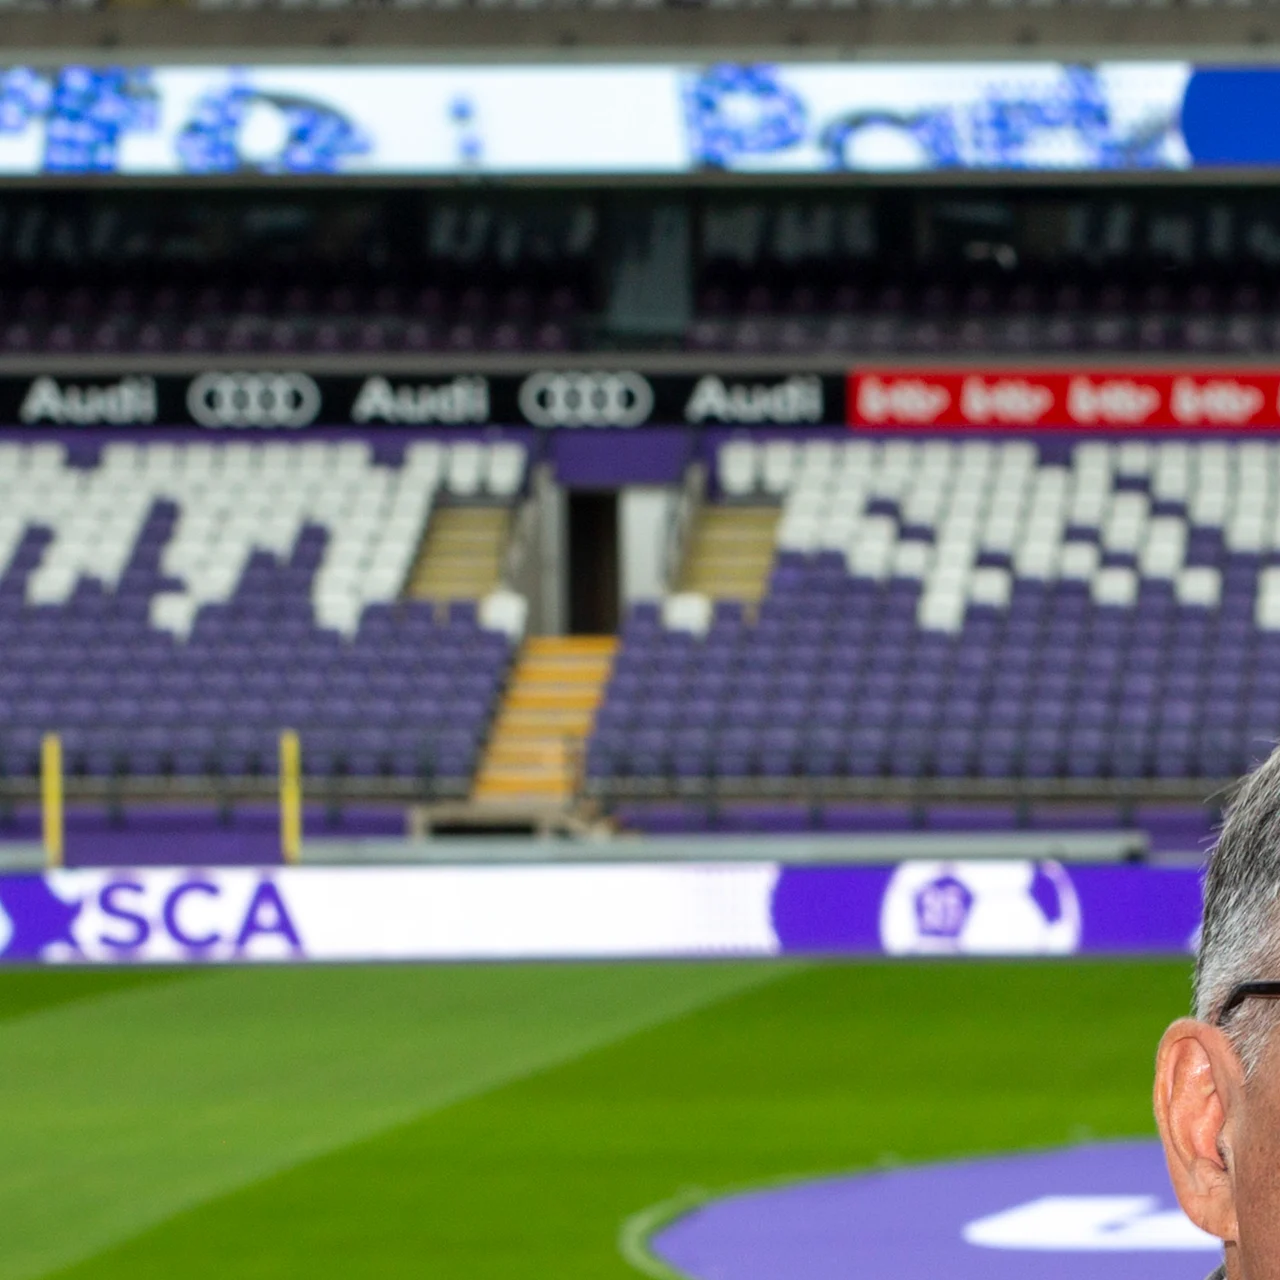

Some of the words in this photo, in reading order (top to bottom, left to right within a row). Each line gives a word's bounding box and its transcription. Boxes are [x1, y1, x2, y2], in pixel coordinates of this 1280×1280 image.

[21, 377, 157, 424] Audi
[352, 377, 489, 424] Audi
[686, 377, 823, 424] Audi
